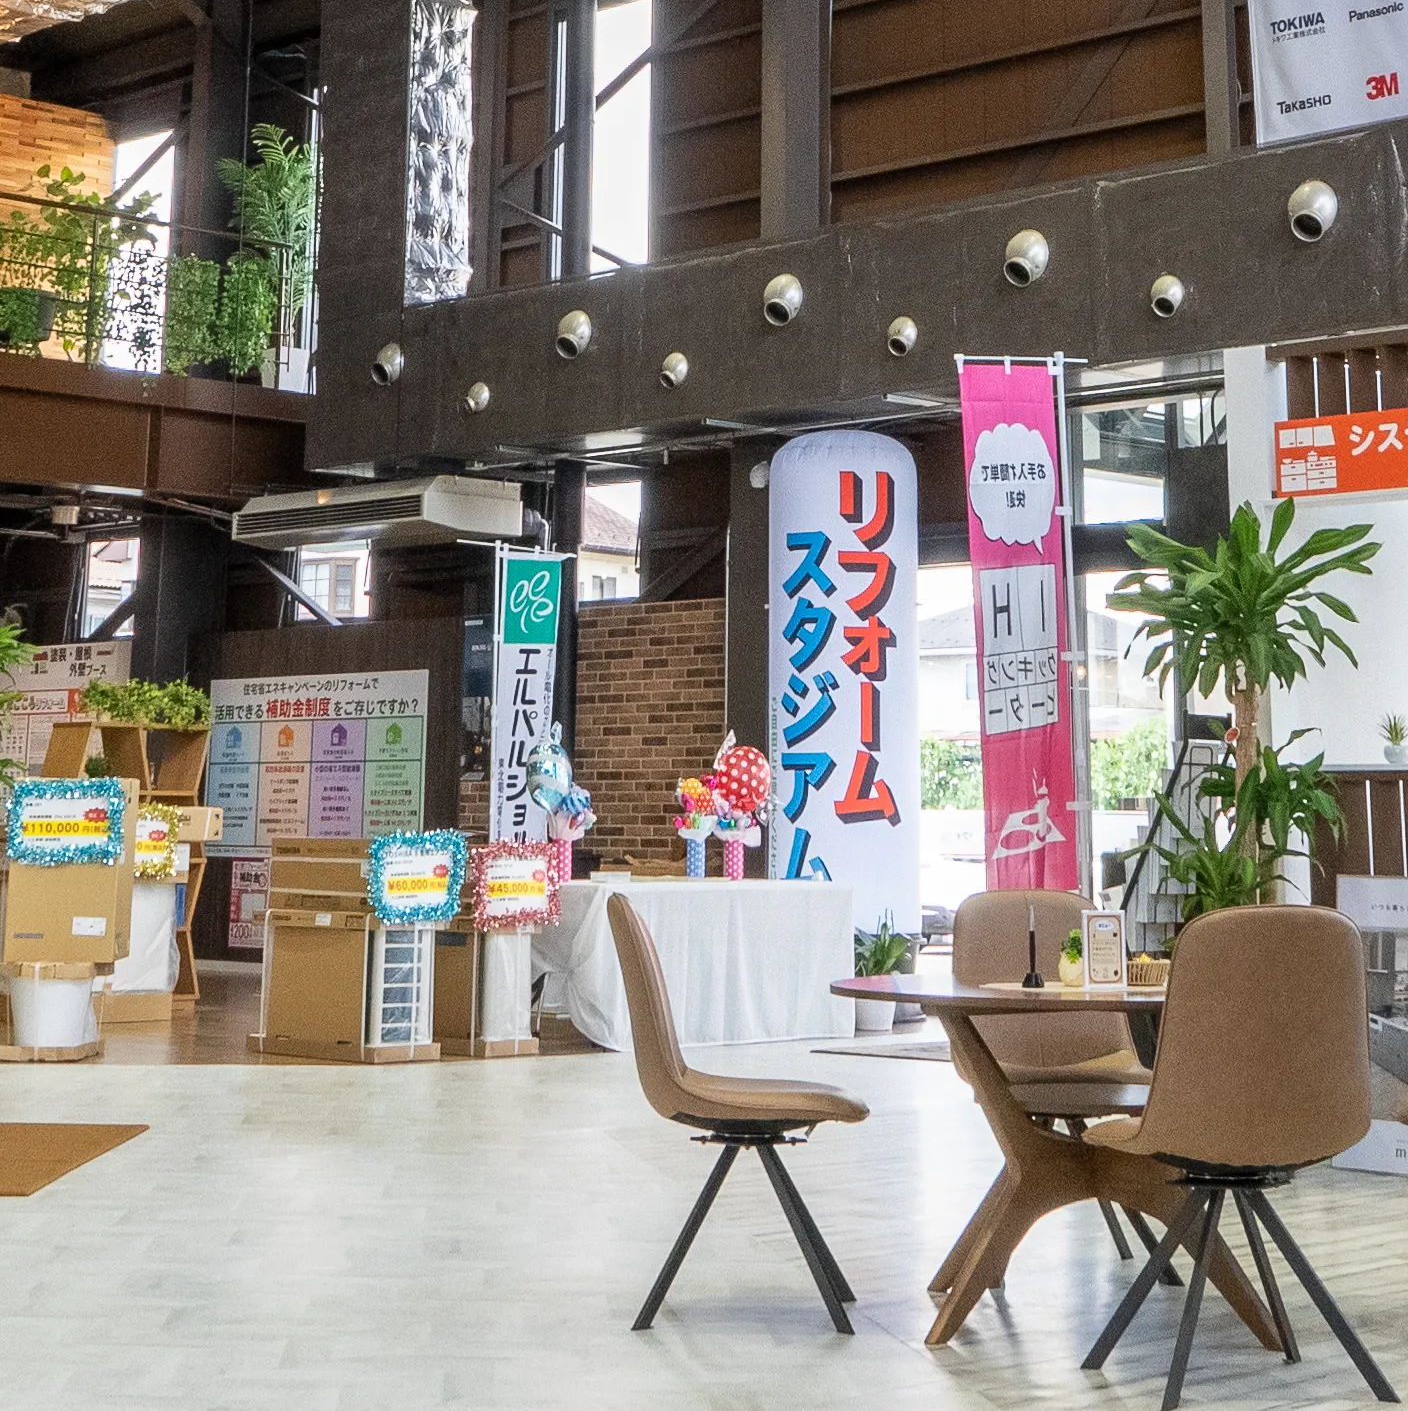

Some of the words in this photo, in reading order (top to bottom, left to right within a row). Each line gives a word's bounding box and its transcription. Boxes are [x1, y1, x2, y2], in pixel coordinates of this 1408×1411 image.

[1349, 1, 1404, 22] Panasonic
[1270, 11, 1325, 35] TOKIWA
[1365, 71, 1400, 101] 3M
[833, 470, 902, 829] リフォーム
[243, 677, 380, 696] 住宅省エネキャンペーンのリフォームで
[214, 703, 264, 721] 活用できる
[265, 696, 332, 718] 補助金制度
[782, 530, 839, 882] スタジアム
[23, 821, 80, 834] ¥110,000
[388, 878, 429, 892] ¥60,000
[488, 882, 529, 894] ¥45,000
